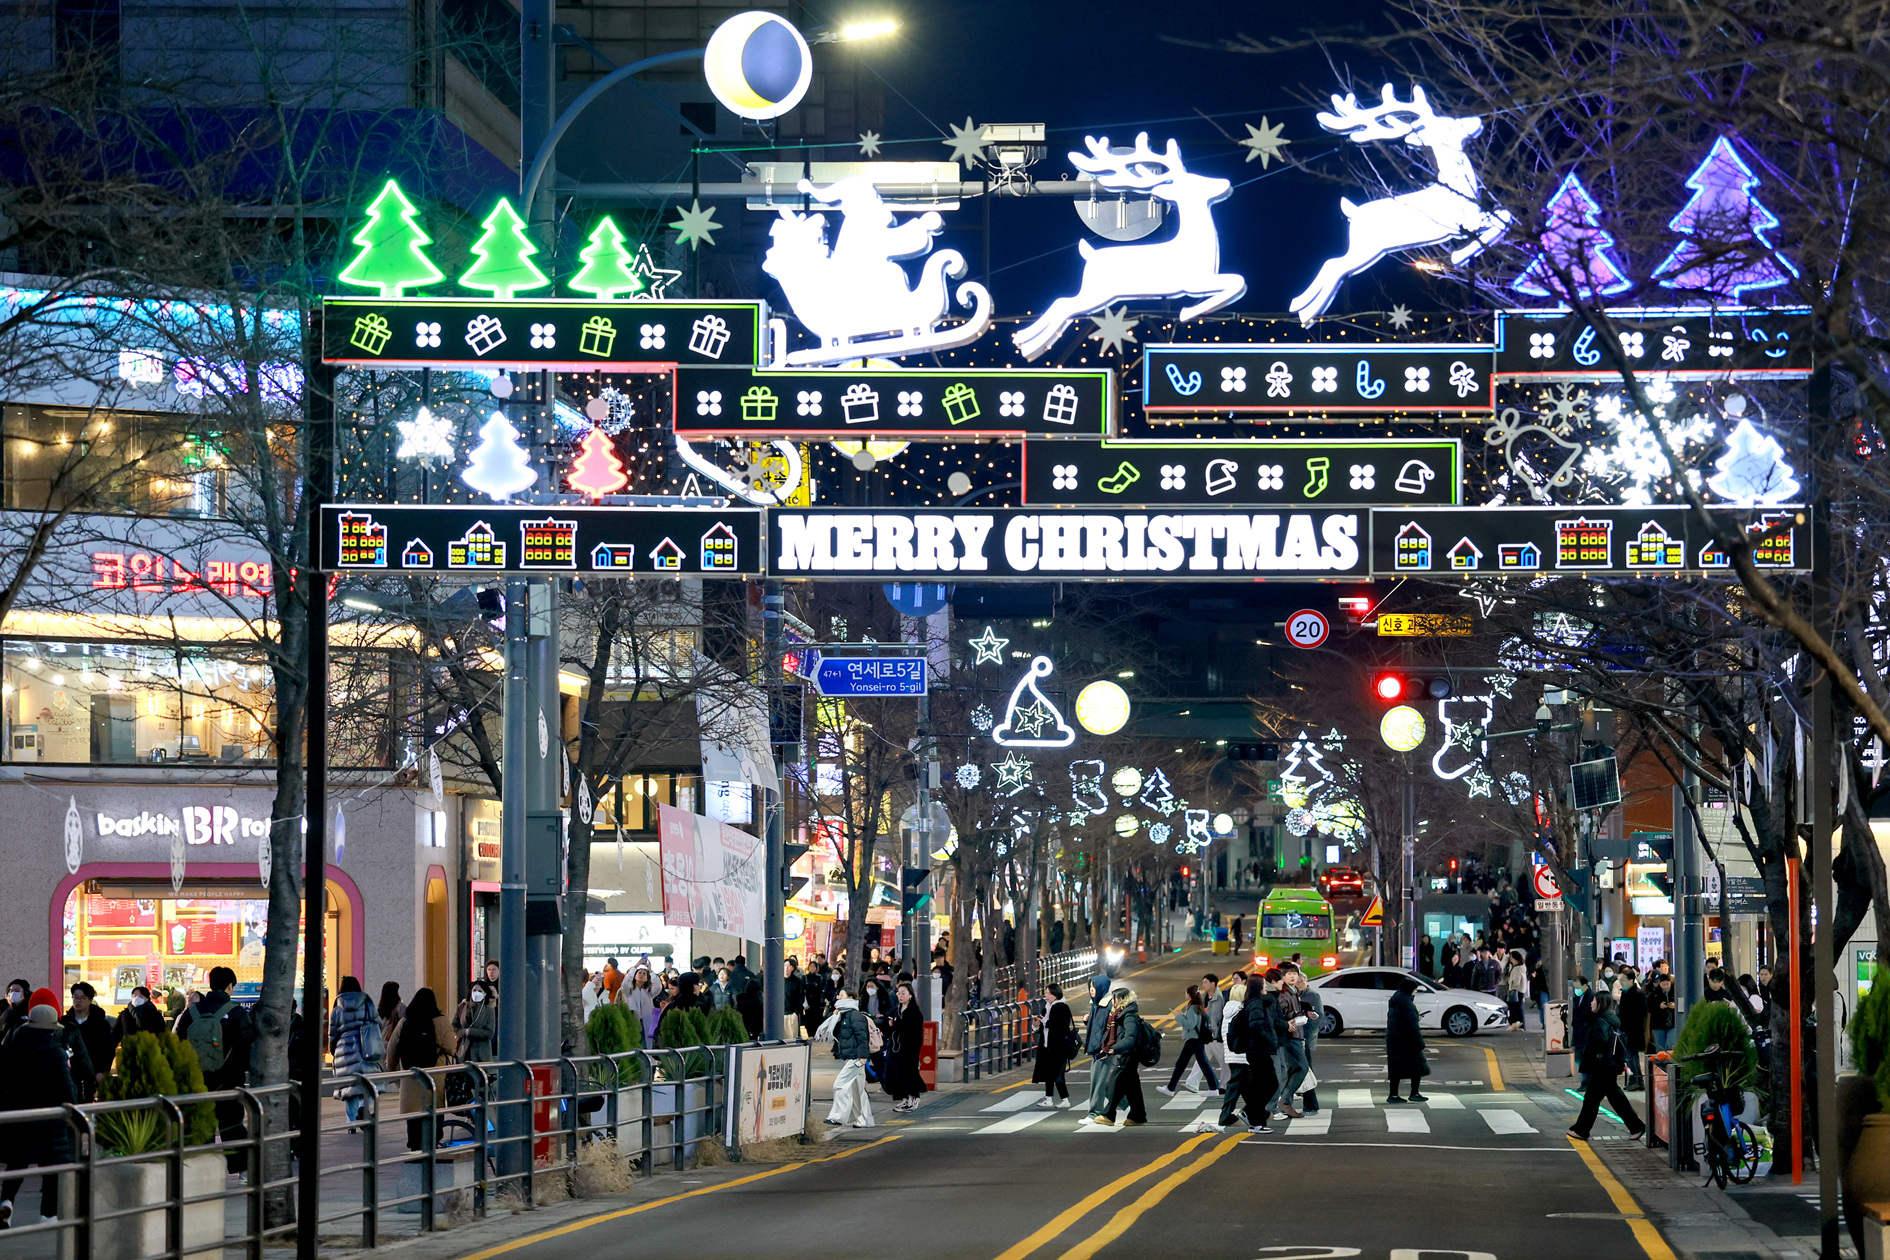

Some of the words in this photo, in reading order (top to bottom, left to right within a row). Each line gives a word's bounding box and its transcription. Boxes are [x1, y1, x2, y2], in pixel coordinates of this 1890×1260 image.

[778, 515, 995, 570] MERRY
[1004, 514, 1360, 571] CHRISTMAS
[1295, 622, 1320, 638] 20
[1383, 617, 1402, 632] 신호
[847, 661, 921, 680] 연세로5길
[850, 682, 896, 691] Yonsei-ro
[899, 682, 921, 693] 5-gil
[97, 811, 180, 838] baskin
[182, 805, 239, 846] BR
